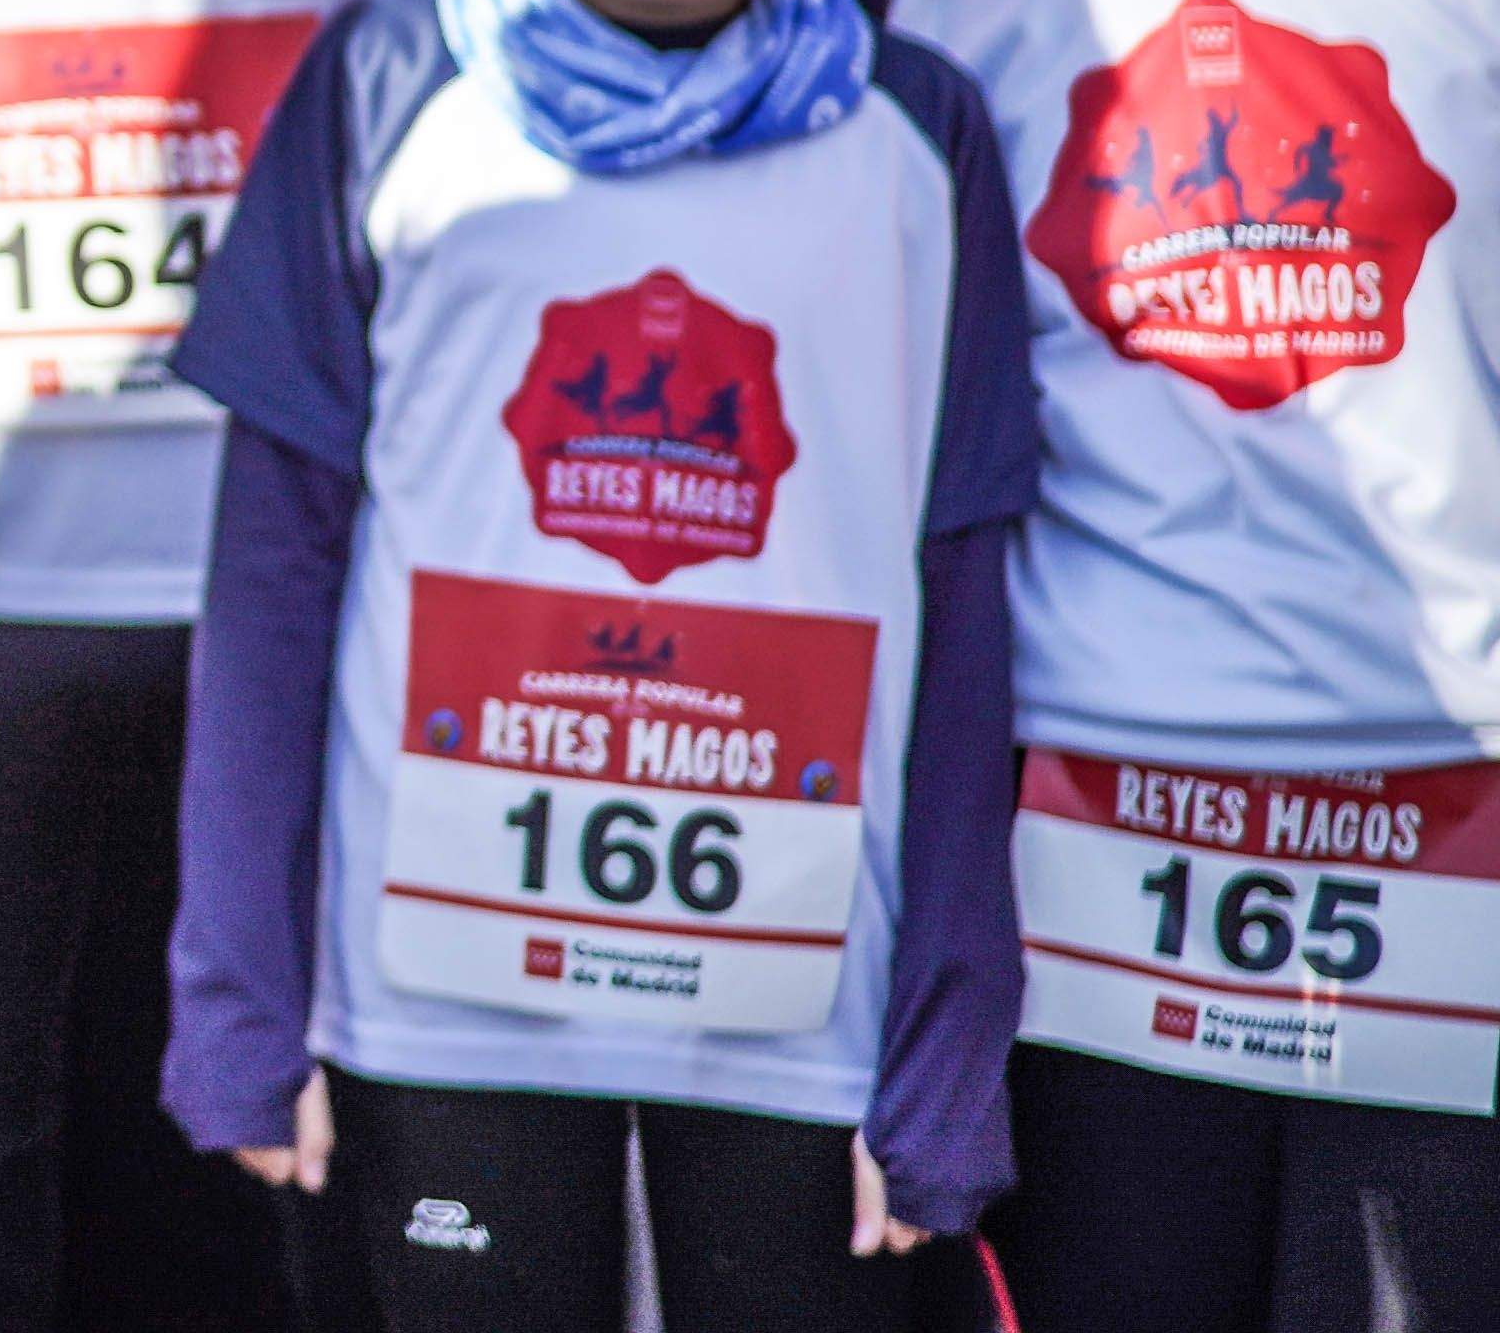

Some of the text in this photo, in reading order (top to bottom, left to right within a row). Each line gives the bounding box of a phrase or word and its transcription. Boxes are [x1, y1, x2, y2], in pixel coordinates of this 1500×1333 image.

[1236, 260, 1385, 327] MAGOS
[545, 459, 760, 527] REYES MAGOS
[479, 696, 779, 792] REYES MAGOS
[1115, 762, 1424, 865] REYES MAGOS
[502, 787, 745, 916] 166
[1140, 852, 1384, 983] 165
[572, 939, 704, 970] Comunidad
[611, 969, 699, 997] Madrid
[1204, 1003, 1338, 1038] Comunidad
[1242, 1032, 1333, 1063] Madrid
